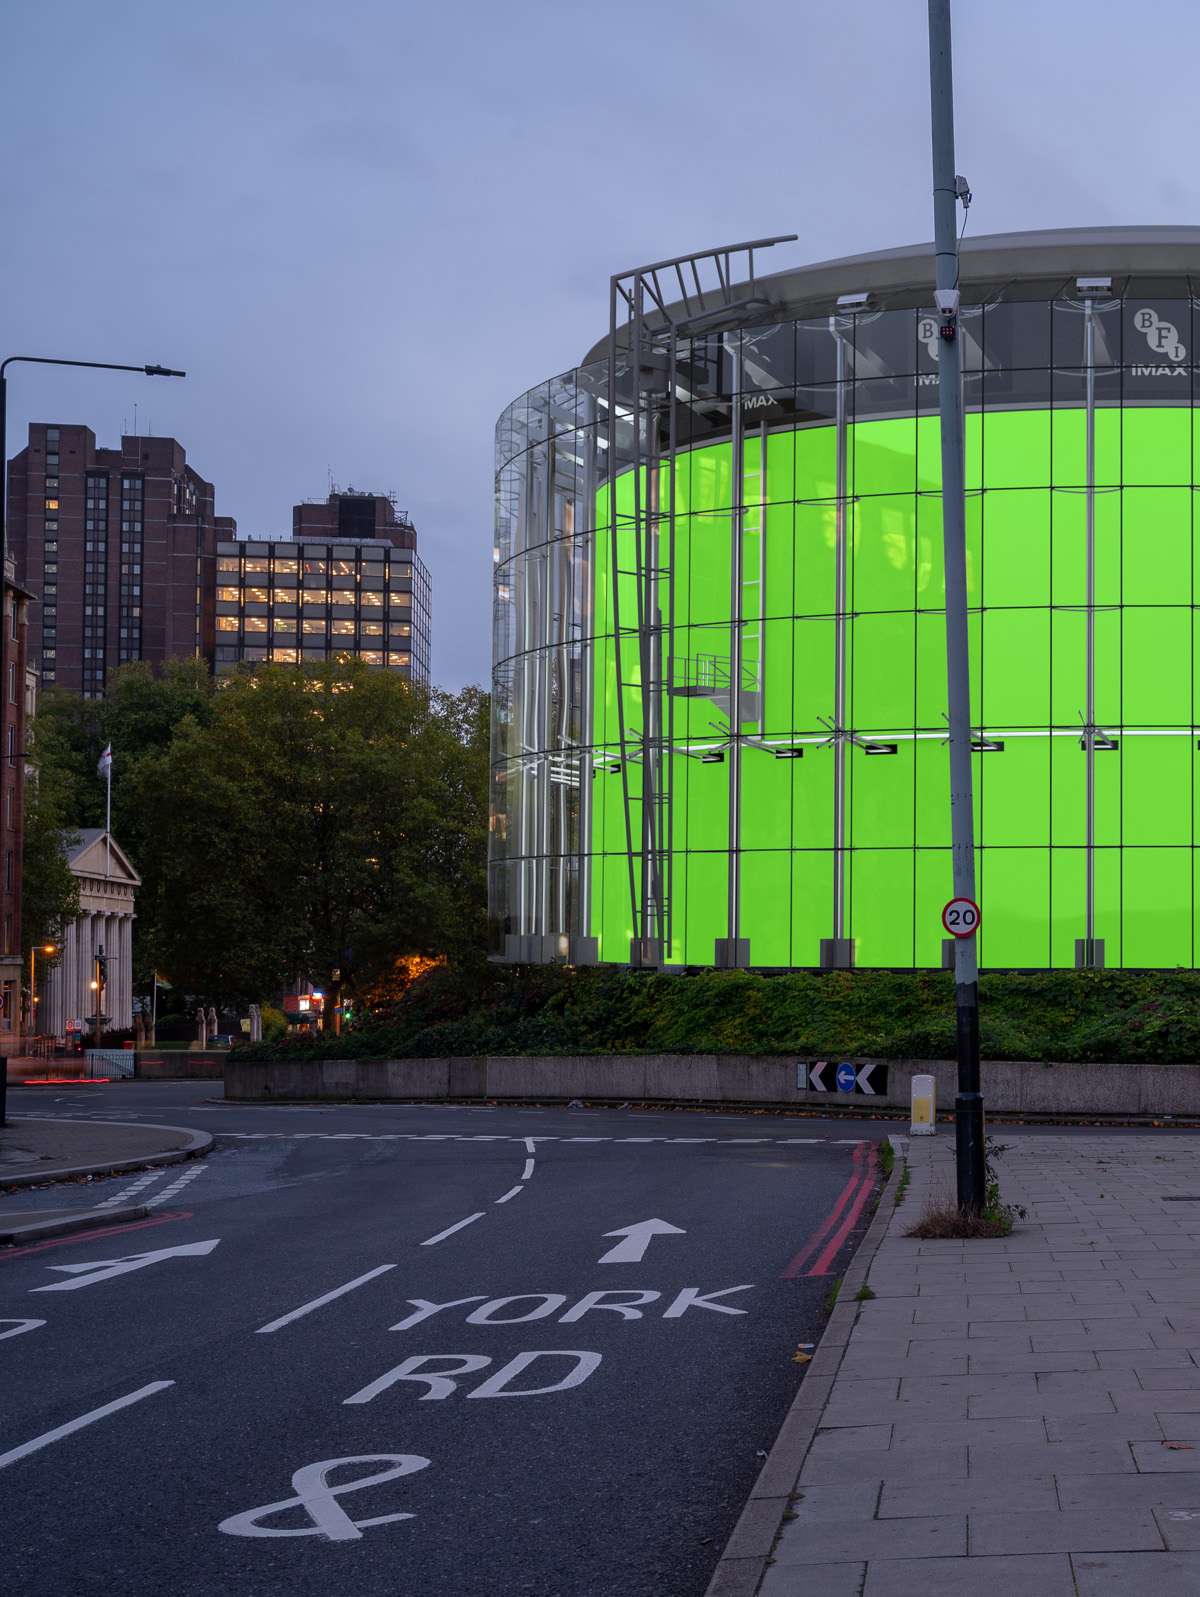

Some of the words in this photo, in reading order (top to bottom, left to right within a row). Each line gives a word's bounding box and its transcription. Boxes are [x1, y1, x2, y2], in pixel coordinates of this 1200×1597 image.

[1138, 310, 1182, 360] BFI
[1131, 364, 1188, 376] IMAX
[744, 394, 778, 410] MAX
[948, 909, 976, 925] 20
[388, 1284, 756, 1331] YORK
[342, 1350, 602, 1404] RD
[217, 1453, 432, 1541] &
